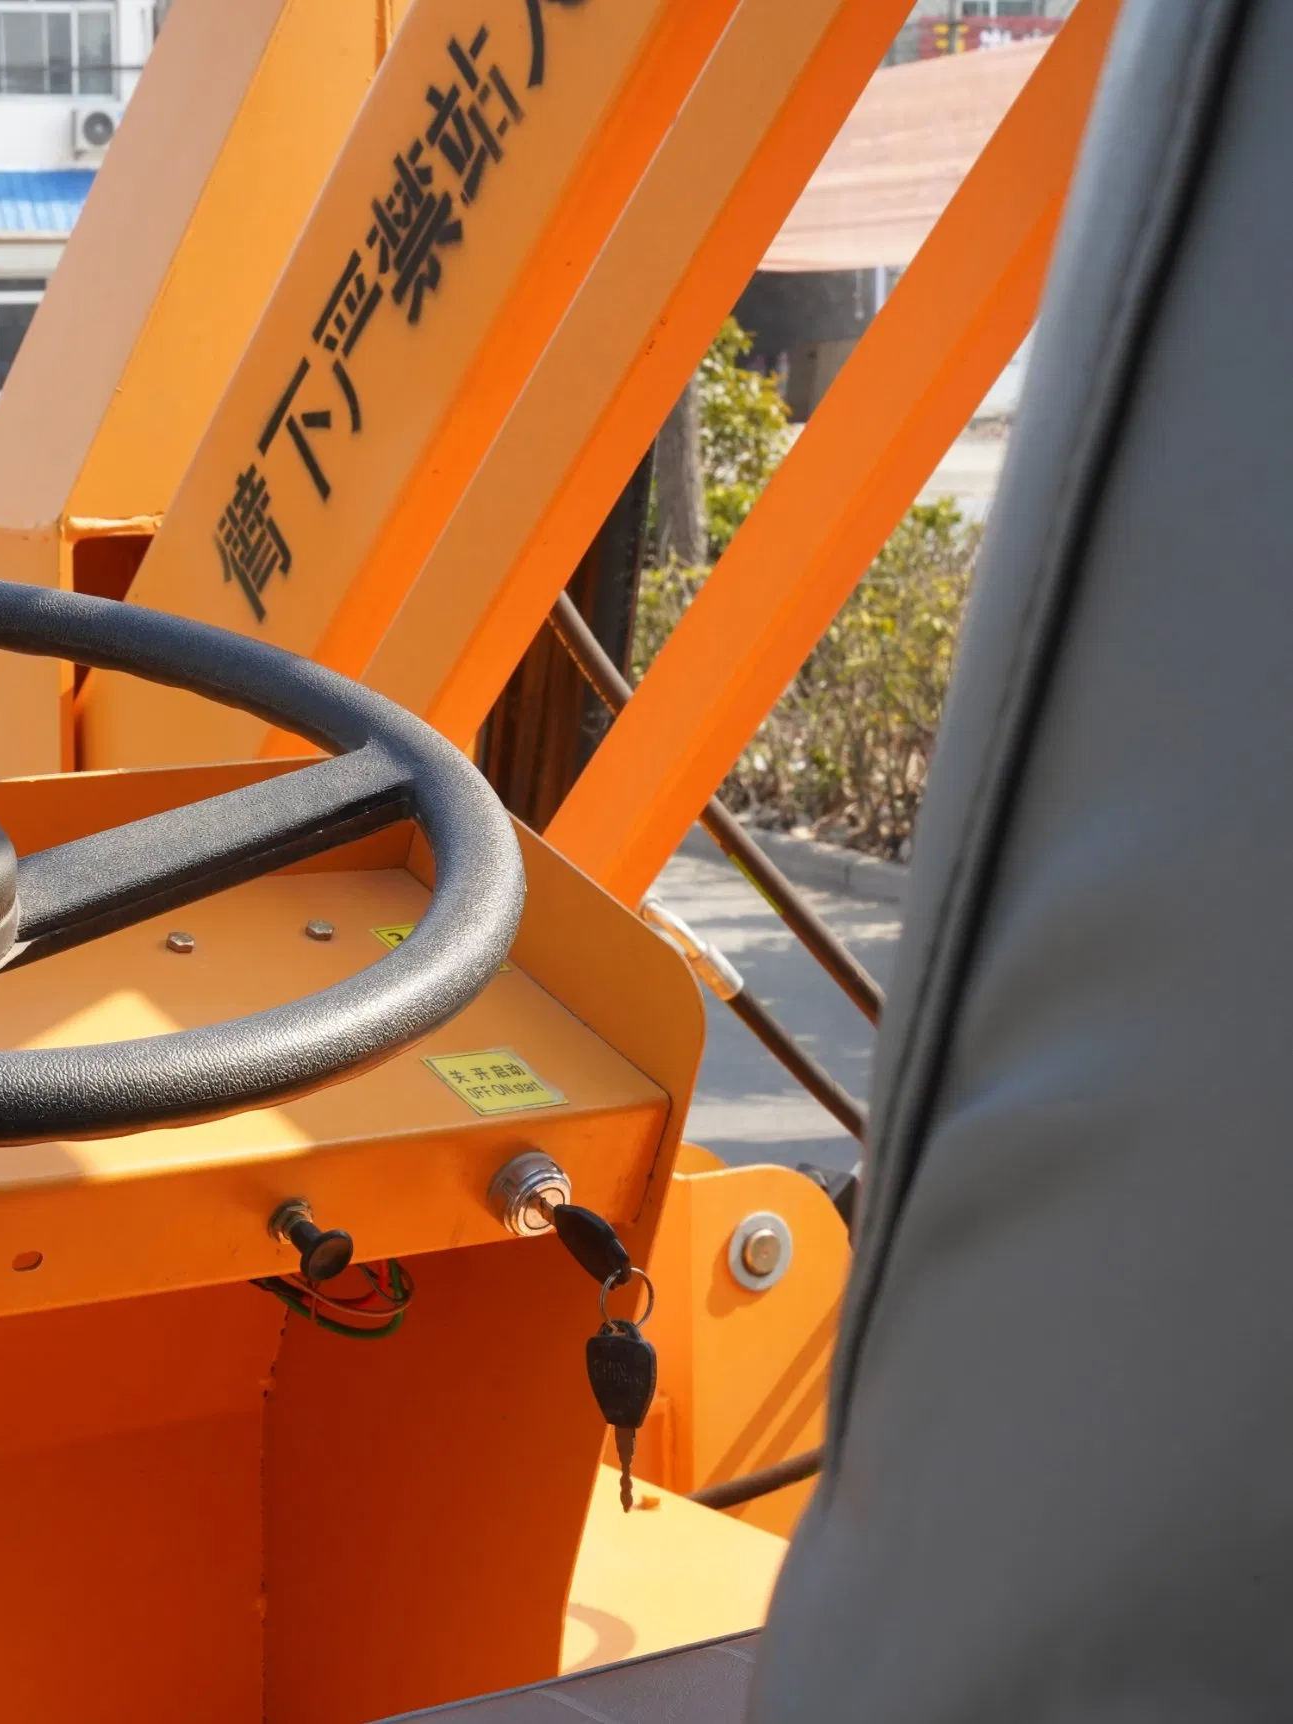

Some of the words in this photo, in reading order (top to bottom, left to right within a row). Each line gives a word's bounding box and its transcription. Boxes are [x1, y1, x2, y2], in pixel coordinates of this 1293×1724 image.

[448, 1068, 470, 1084] 关
[470, 1067, 490, 1081] 开
[489, 1062, 526, 1079] 启动
[466, 1085, 492, 1100] OFF
[491, 1083, 515, 1096] ON
[513, 1080, 544, 1094] start
